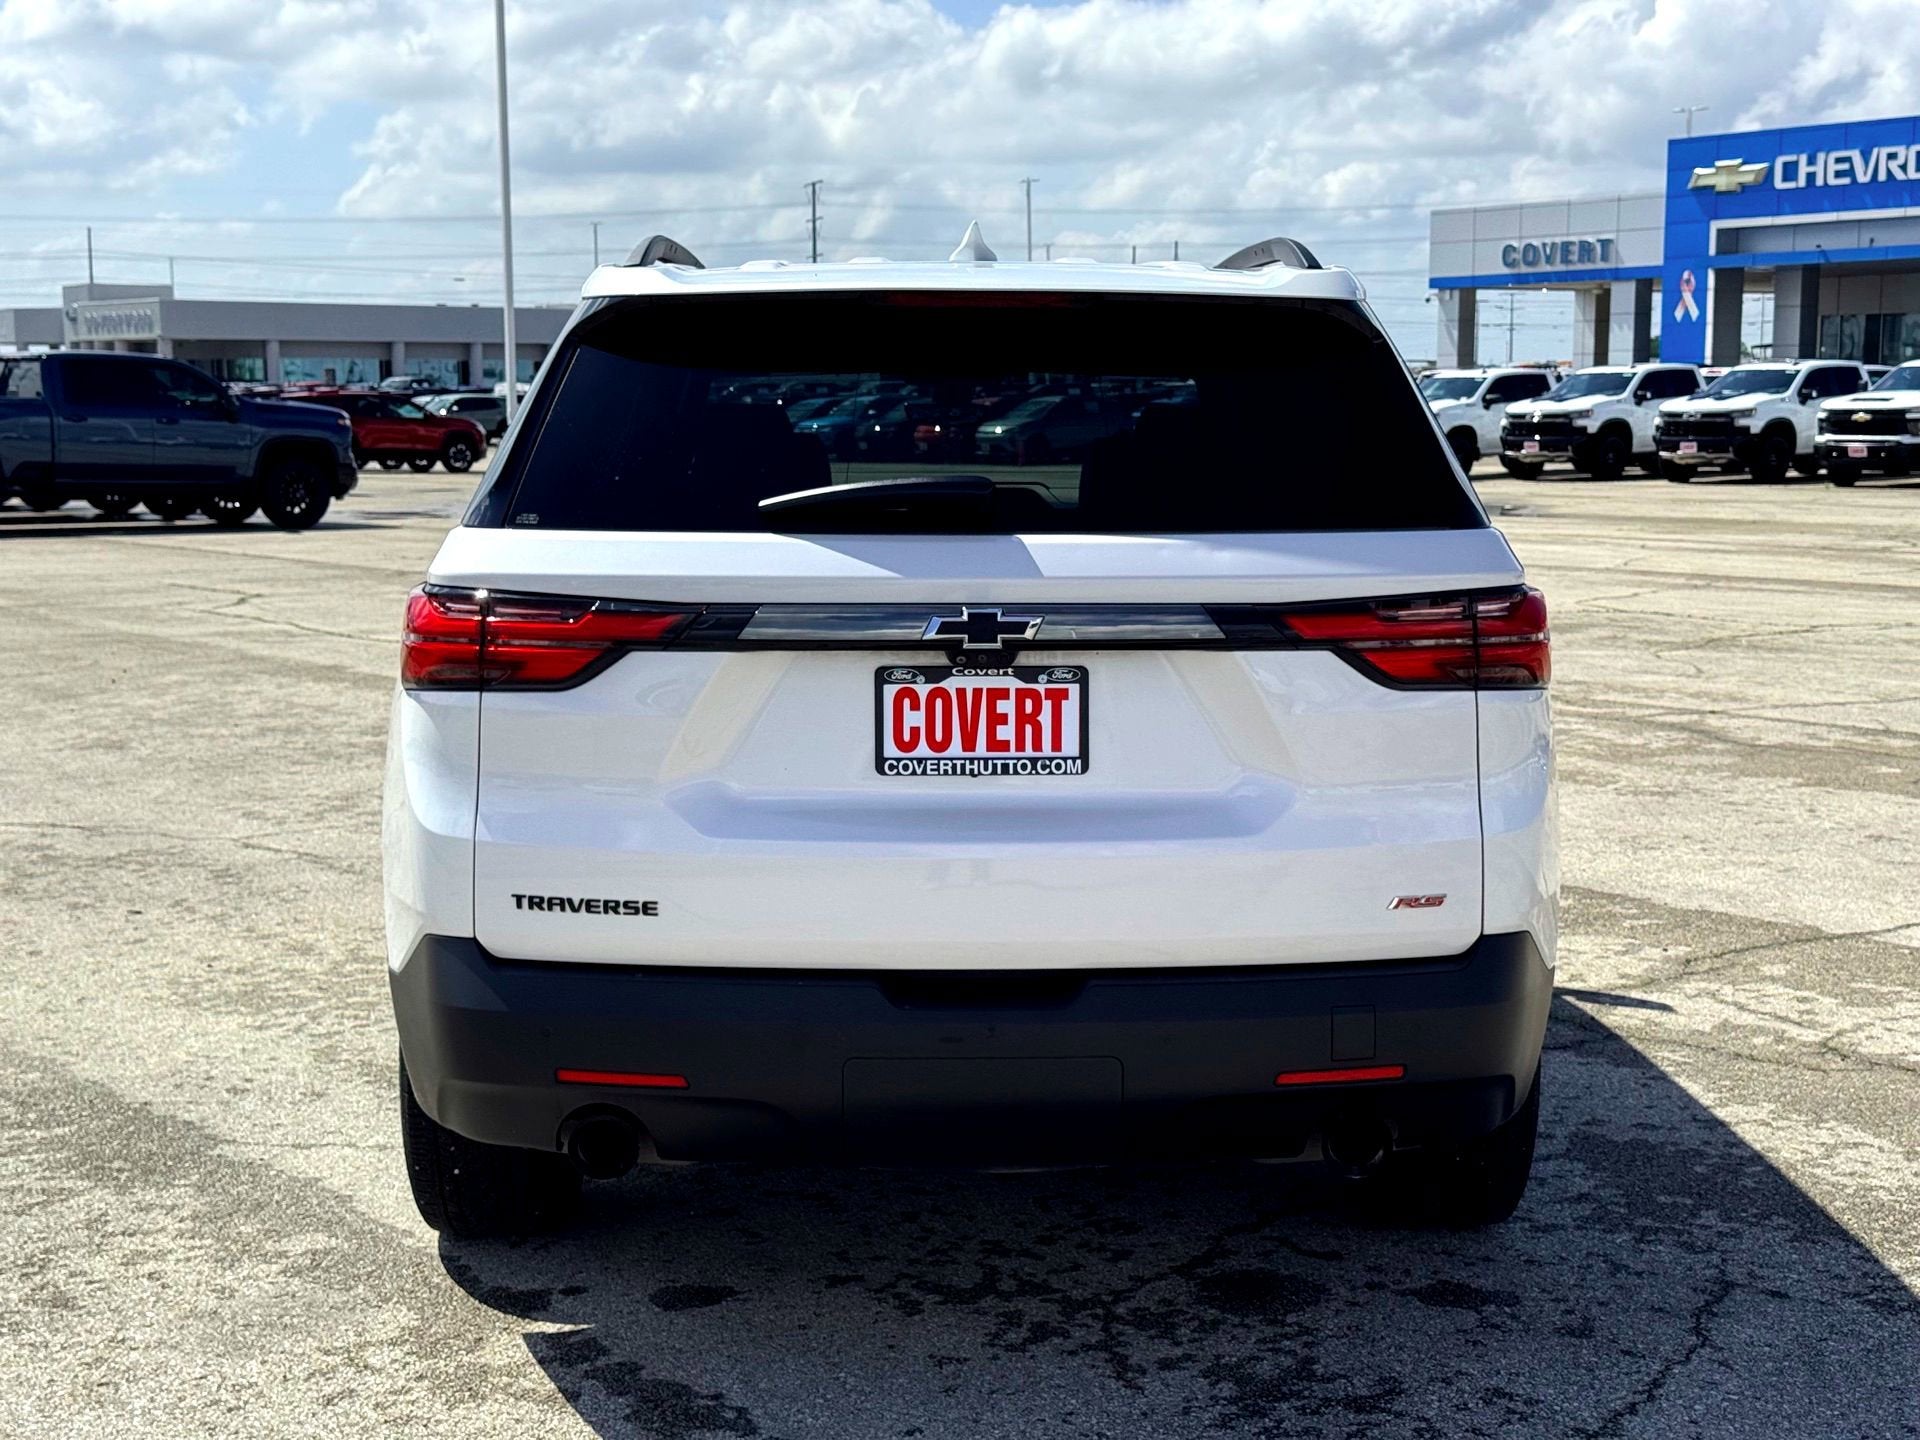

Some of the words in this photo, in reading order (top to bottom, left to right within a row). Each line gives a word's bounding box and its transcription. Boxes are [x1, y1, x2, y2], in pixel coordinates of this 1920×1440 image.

[1502, 238, 1614, 269] COVERT
[951, 666, 1015, 676] Covert
[893, 686, 1069, 753] COVERT
[884, 759, 1082, 775] COVERTHUTTO.COM
[511, 893, 659, 916] TRAVERSE
[1386, 893, 1447, 910] RS
